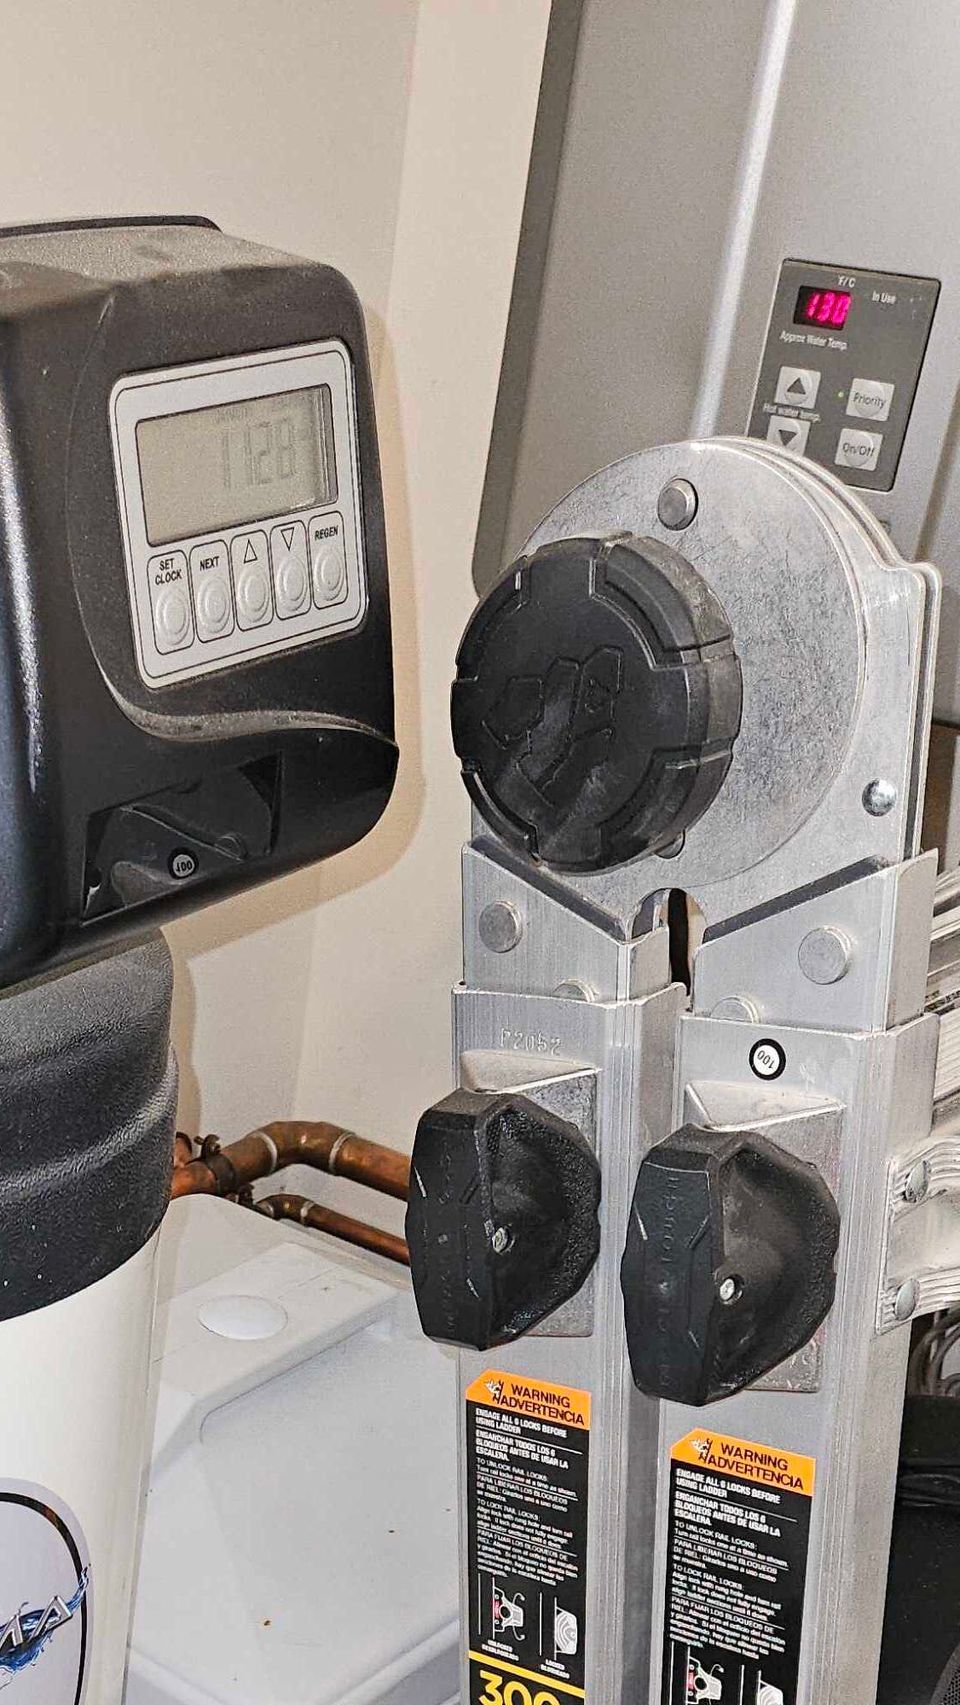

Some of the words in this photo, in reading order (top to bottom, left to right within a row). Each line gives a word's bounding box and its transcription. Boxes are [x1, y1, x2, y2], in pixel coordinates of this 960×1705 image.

[853, 392, 886, 409] Priority
[843, 442, 875, 457] On/Off
[314, 526, 339, 541] REGEN
[159, 558, 174, 571] SET
[200, 556, 220, 571] NEXT
[155, 569, 182, 586] CLOCK
[511, 1383, 570, 1408] WARNING
[500, 1397, 585, 1426] ADVERTENCIA
[496, 1422, 521, 1435] LADDER
[502, 1413, 513, 1424] ALL
[520, 1419, 541, 1431] LOCKS
[542, 1425, 567, 1438] BEFORE
[476, 1438, 509, 1453] BLOQUEOS
[510, 1446, 530, 1459] ANTES
[531, 1452, 540, 1461] DE
[541, 1454, 558, 1466] USAR
[559, 1460, 569, 1469] LA
[537, 1444, 549, 1456] LOS
[720, 1442, 788, 1471] WARNING
[707, 1456, 804, 1490] ADVERTENCIA
[676, 1468, 705, 1482] ENGAGE
[706, 1475, 719, 1487] ALL
[727, 1482, 751, 1496] LOCKS
[752, 1489, 781, 1504] BEFORE
[676, 1477, 698, 1490] USING
[699, 1483, 728, 1498] LADDER
[675, 1500, 712, 1516] BLOQUEOS
[712, 1511, 736, 1525] ANTES
[737, 1518, 748, 1528] DE
[748, 1521, 769, 1535] USAR
[770, 1527, 781, 1538] LA
[720, 1502, 744, 1517] TODOS
[745, 1509, 759, 1521] LOS
[686, 1523, 714, 1537] UNLOCK
[723, 1552, 737, 1562] LOS
[673, 1563, 682, 1571] TO
[684, 1567, 702, 1578] LOCK
